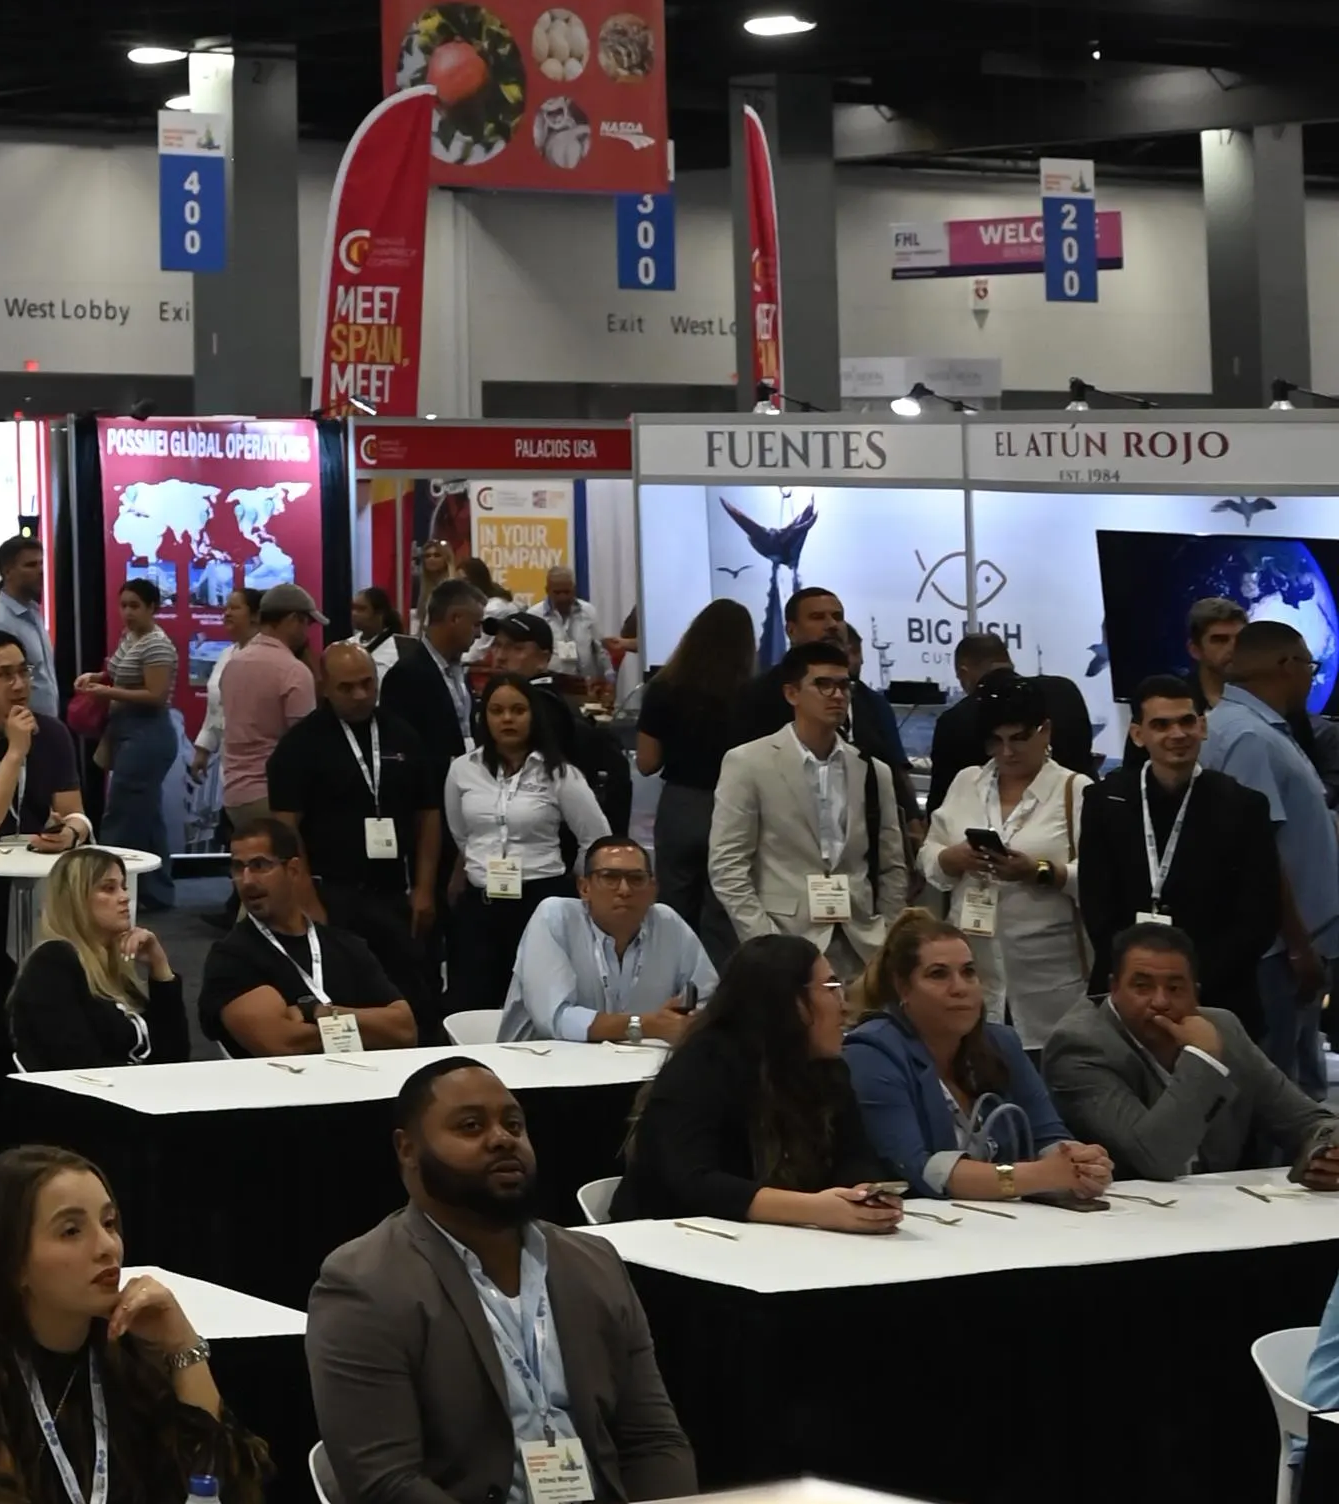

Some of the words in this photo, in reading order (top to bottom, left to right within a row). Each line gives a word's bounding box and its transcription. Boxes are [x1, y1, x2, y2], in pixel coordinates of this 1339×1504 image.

[183, 170, 202, 255] 400
[1060, 204, 1080, 297] 200
[4, 297, 56, 320] West
[61, 299, 130, 326] Lobby
[159, 301, 191, 322] Exi
[333, 284, 401, 325] MEET
[607, 313, 645, 334] Exit
[670, 316, 715, 336] West
[329, 363, 395, 403] MEET
[106, 428, 168, 457] POSSMEI
[170, 430, 224, 459] GLOBAL
[226, 432, 312, 462] OPERATIONS
[515, 438, 571, 459] PALACIOS
[573, 439, 597, 459] USA
[705, 430, 887, 470] FUENTES
[994, 430, 1019, 458] EL
[1026, 424, 1108, 459] ATÚN
[1124, 430, 1230, 465] ROJO
[1059, 469, 1085, 483] EST.
[1087, 468, 1121, 483] 1984
[479, 524, 498, 546] IN
[502, 524, 548, 547] YOUR
[479, 547, 563, 569] COMPANY
[907, 617, 953, 645] BIG
